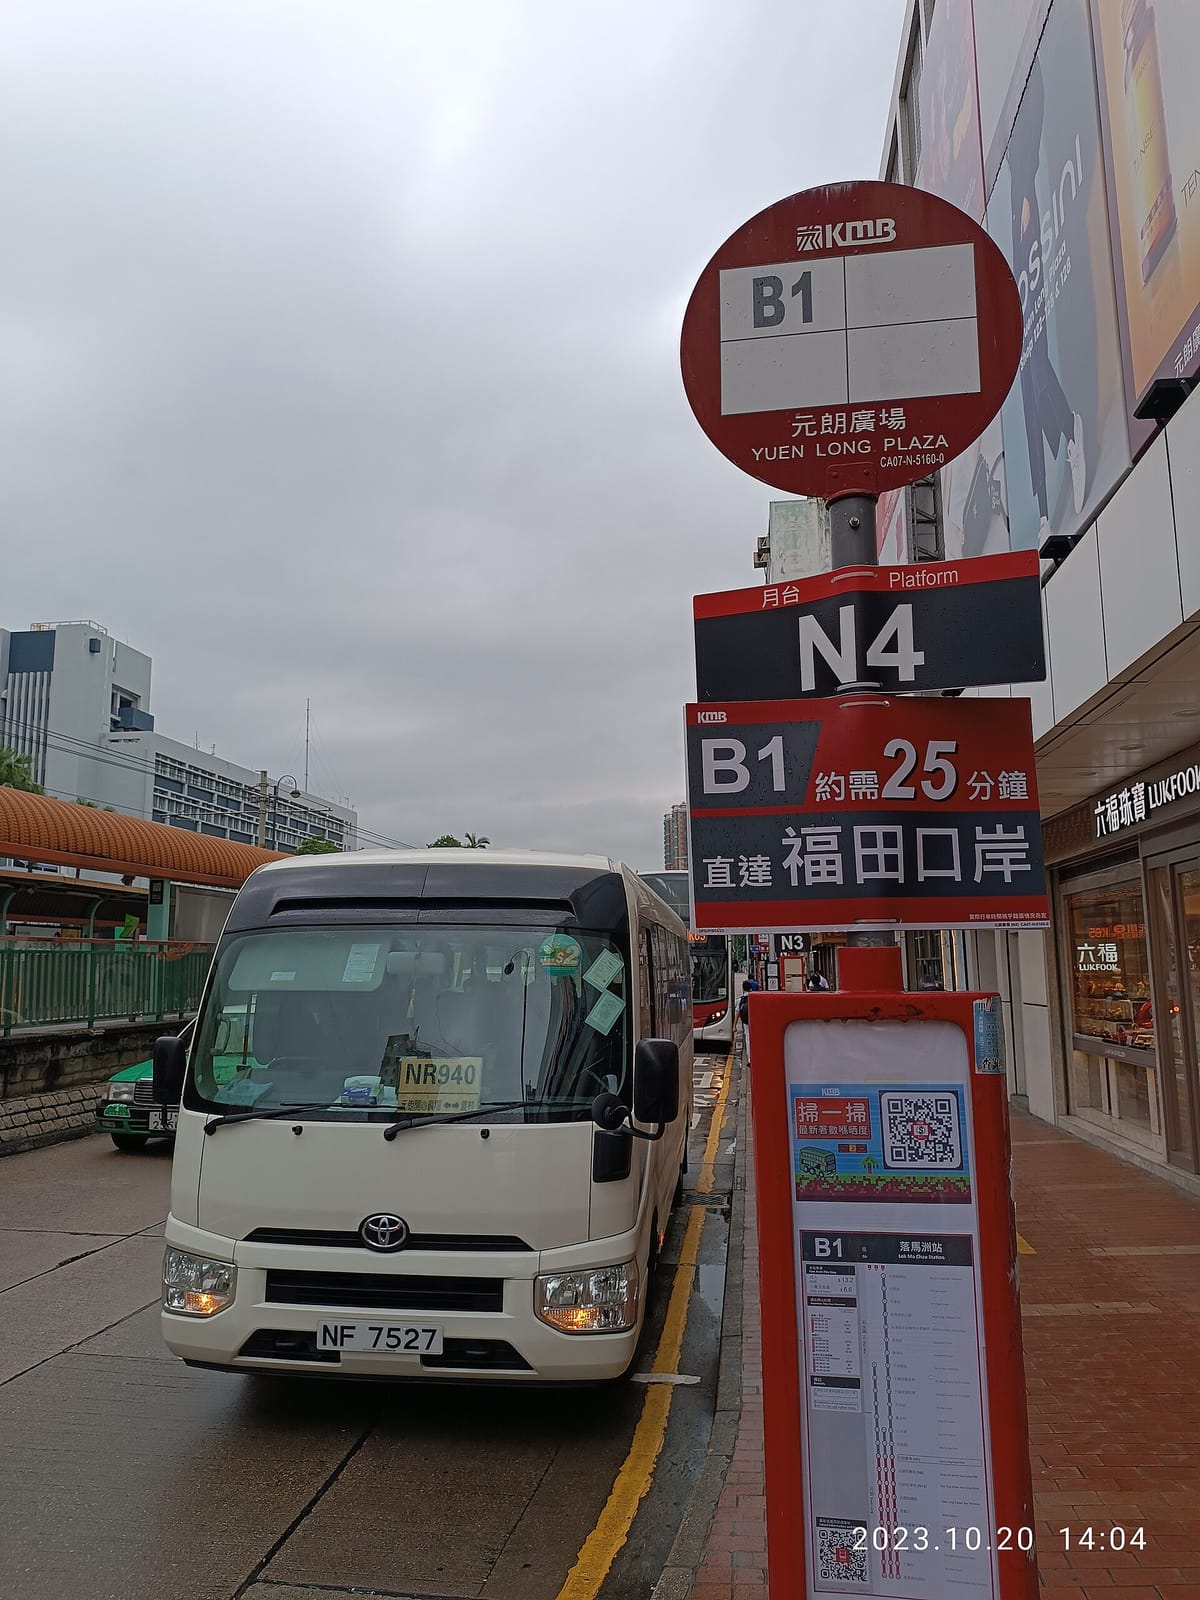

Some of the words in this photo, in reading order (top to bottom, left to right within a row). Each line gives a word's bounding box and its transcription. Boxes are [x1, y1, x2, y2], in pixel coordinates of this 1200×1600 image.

[825, 218, 897, 248] KMB
[1018, 133, 1083, 313] ossini
[752, 271, 814, 329] B1
[791, 408, 907, 438] 元朗廣場
[752, 444, 805, 462] YUEN
[816, 439, 872, 458] LONG
[884, 434, 949, 452] PLAZA
[880, 453, 945, 469] CA07-N-5160-0
[889, 568, 959, 589] Platform
[761, 585, 800, 608] 月台
[798, 603, 925, 692] N4
[697, 711, 728, 724] KMB
[701, 736, 786, 795] B1
[1094, 782, 1146, 838] 六福珠寶
[781, 935, 804, 950] N3
[1077, 943, 1118, 963] 六福
[1079, 963, 1118, 971] LUKFOOK
[405, 1063, 476, 1085] NR940
[822, 1087, 841, 1097] KMB
[798, 1102, 867, 1124] 掃一掃
[814, 1237, 843, 1258] B1
[899, 1241, 943, 1254] 落馬洲站
[322, 1325, 356, 1347] NF
[368, 1326, 437, 1350] 7527
